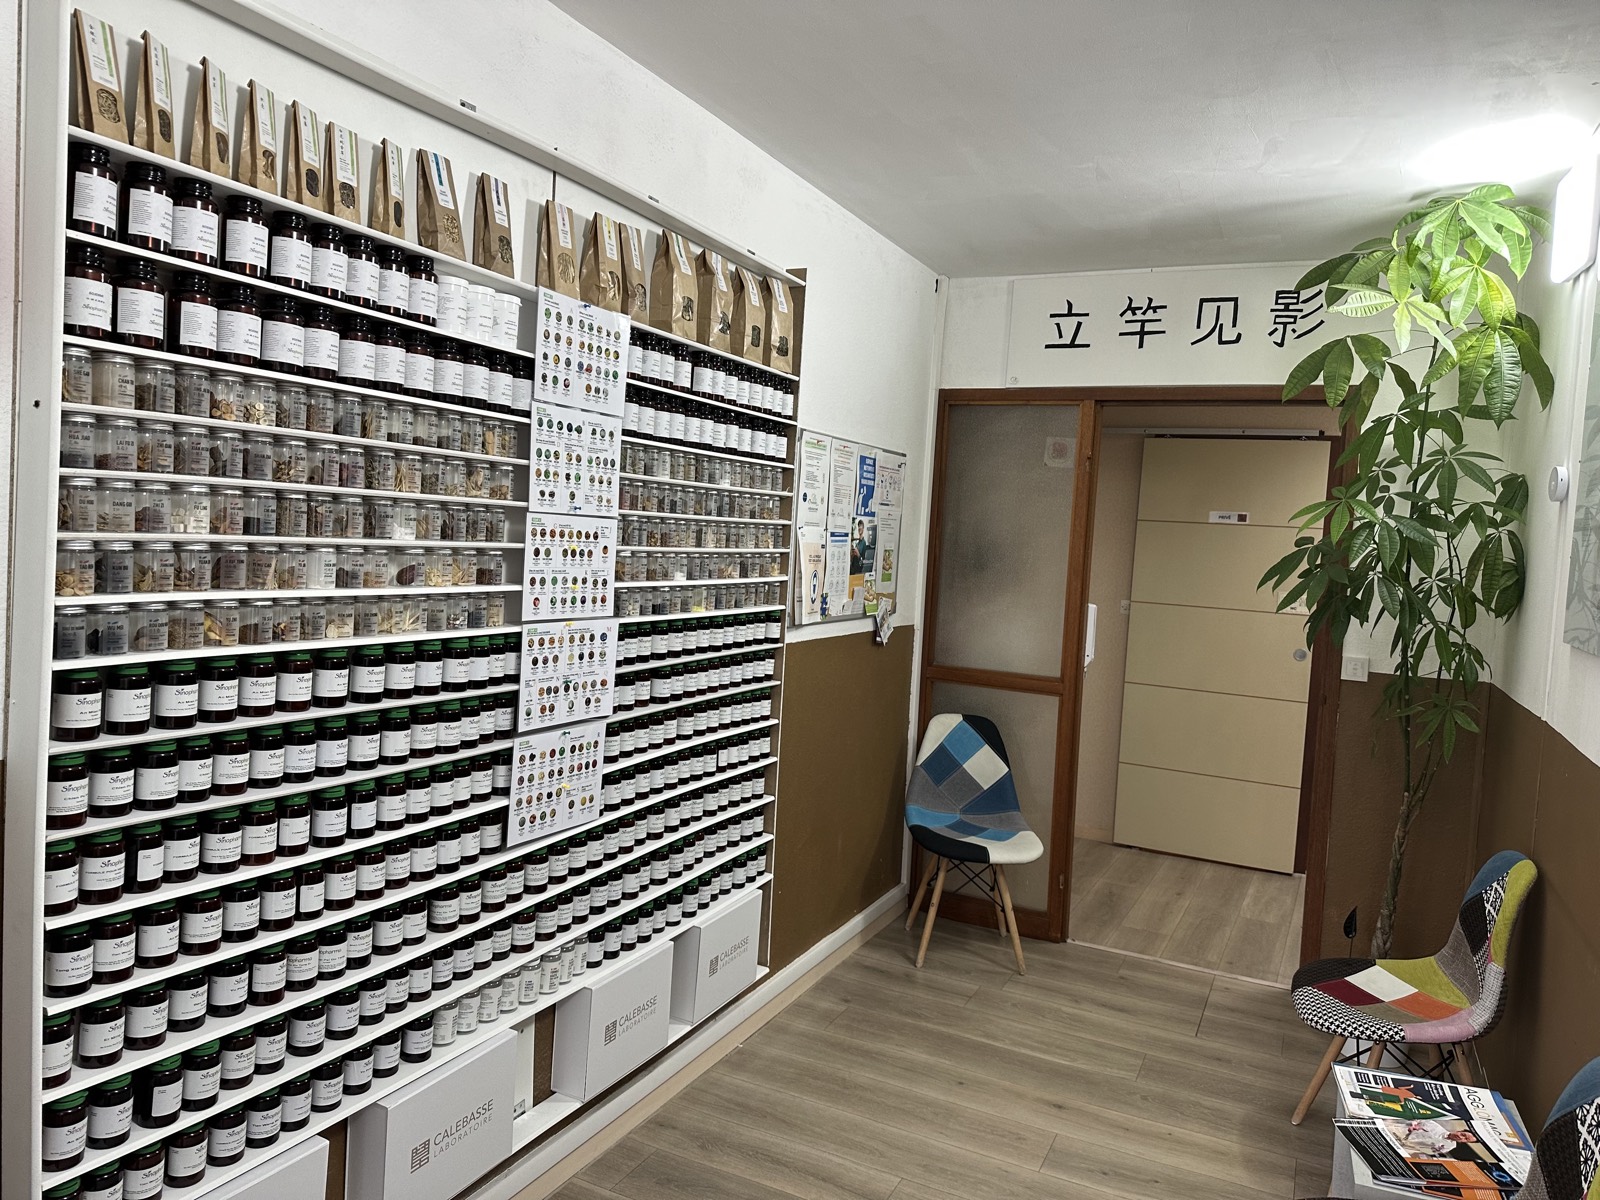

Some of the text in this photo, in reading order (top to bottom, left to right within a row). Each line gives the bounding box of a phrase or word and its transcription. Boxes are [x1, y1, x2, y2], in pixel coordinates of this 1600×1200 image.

[1044, 288, 1326, 350] 立竿见影
[720, 935, 750, 962] CALEBASSE
[619, 995, 657, 1027] CALEBASSE
[619, 1007, 657, 1037] LABORATOIRE
[434, 1098, 494, 1146] CALEBASSE
[434, 1113, 493, 1158] LABORATOIRE
